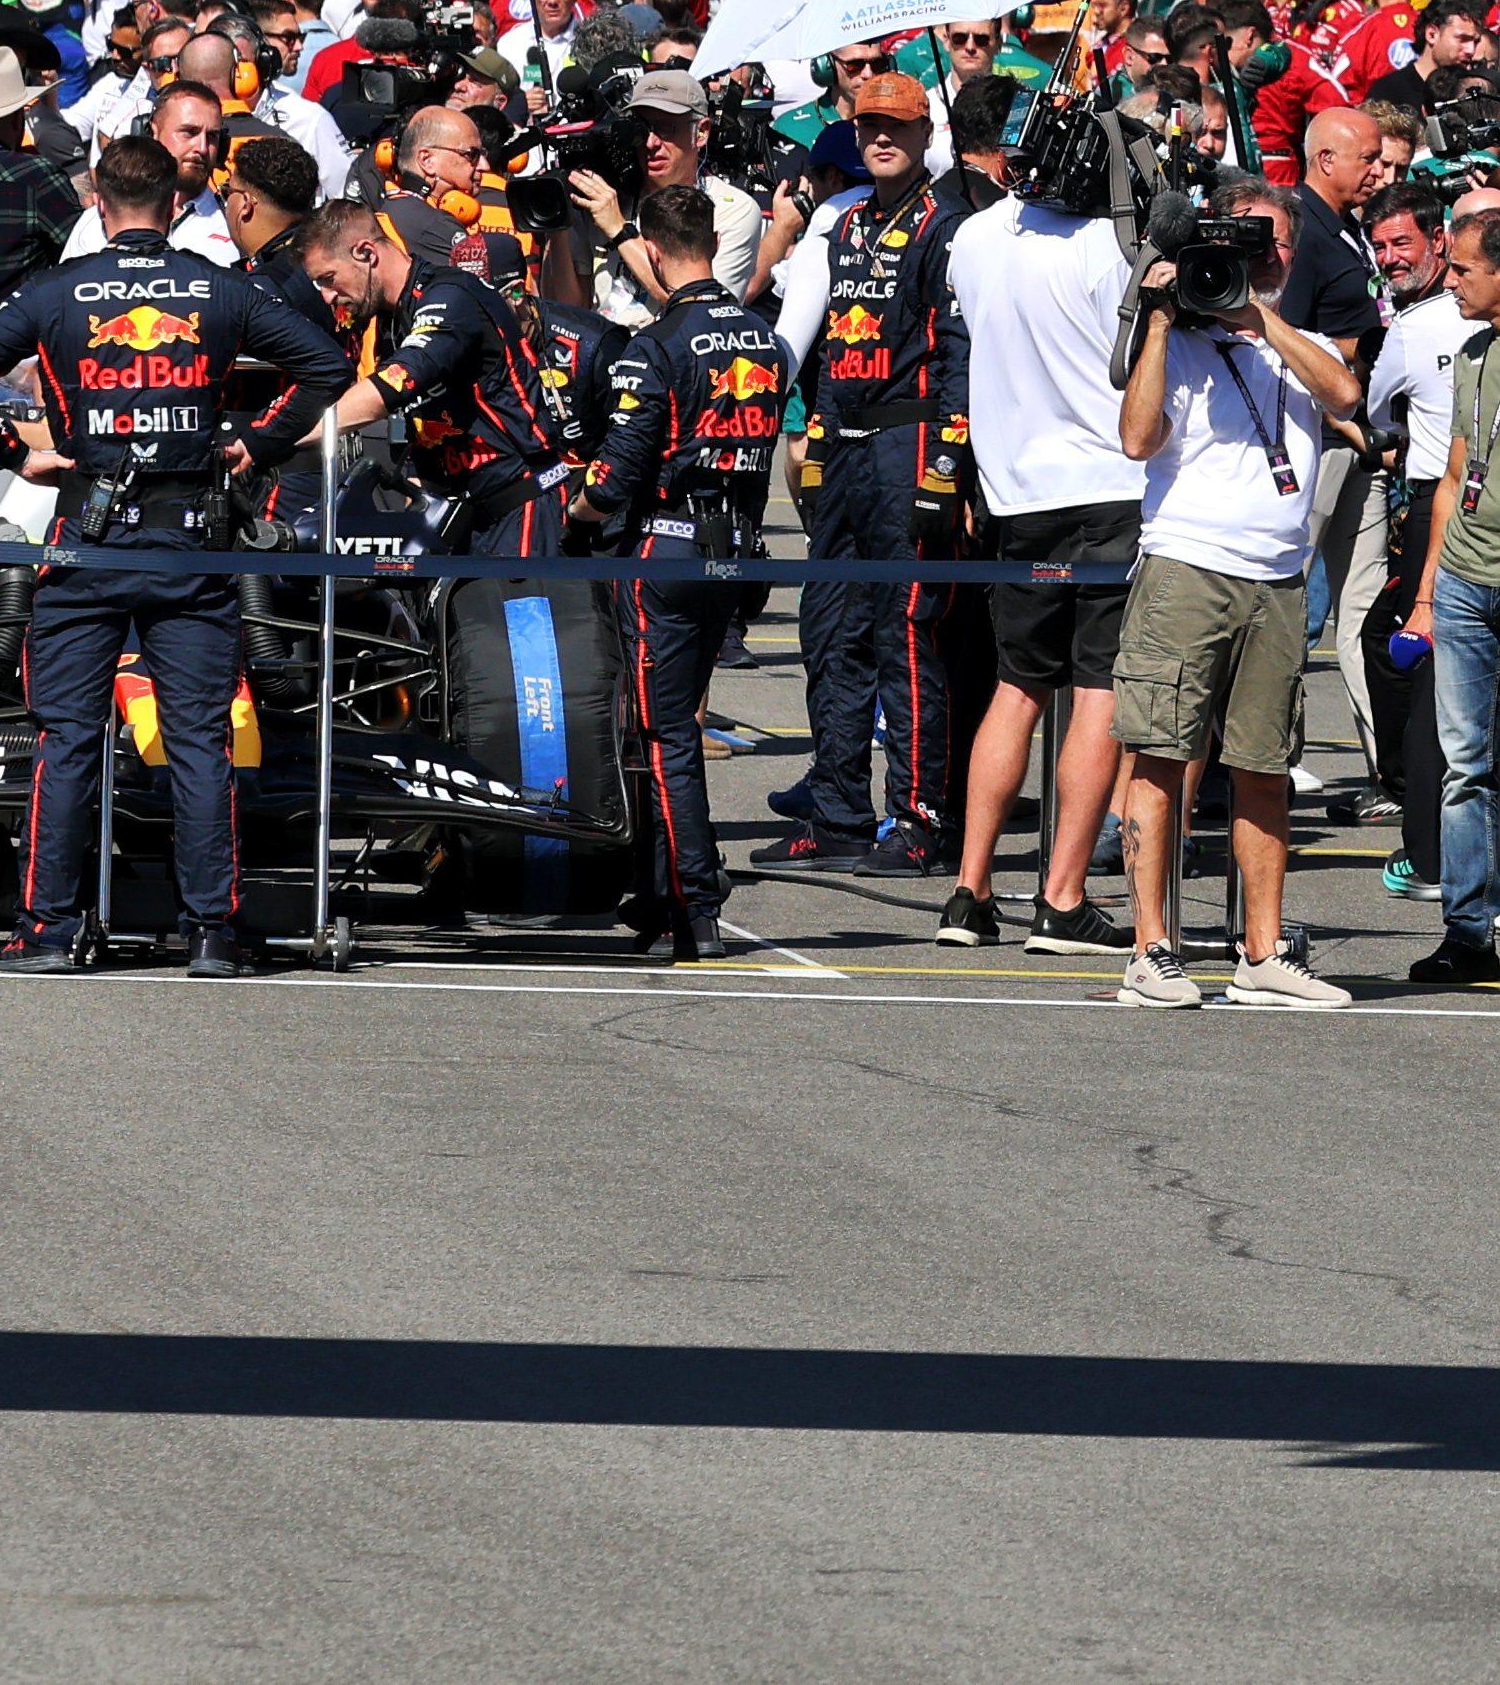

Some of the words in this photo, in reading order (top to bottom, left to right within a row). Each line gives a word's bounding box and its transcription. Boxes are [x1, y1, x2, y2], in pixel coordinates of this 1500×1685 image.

[840, 12, 900, 32] WILLIAMS
[901, 3, 947, 19] RACING
[73, 278, 212, 303] ORACLE
[690, 330, 778, 356] ORACLE
[78, 354, 143, 390] Red
[148, 354, 211, 389] Bull
[87, 407, 169, 436] Mobil
[694, 405, 744, 439] Red
[695, 446, 761, 471] Mobil
[42, 545, 79, 564] flex
[374, 556, 414, 565] ORACLE
[1032, 562, 1072, 571] ORACLE
[705, 560, 739, 578] flex
[523, 675, 538, 717] Left
[536, 675, 554, 732] Front
